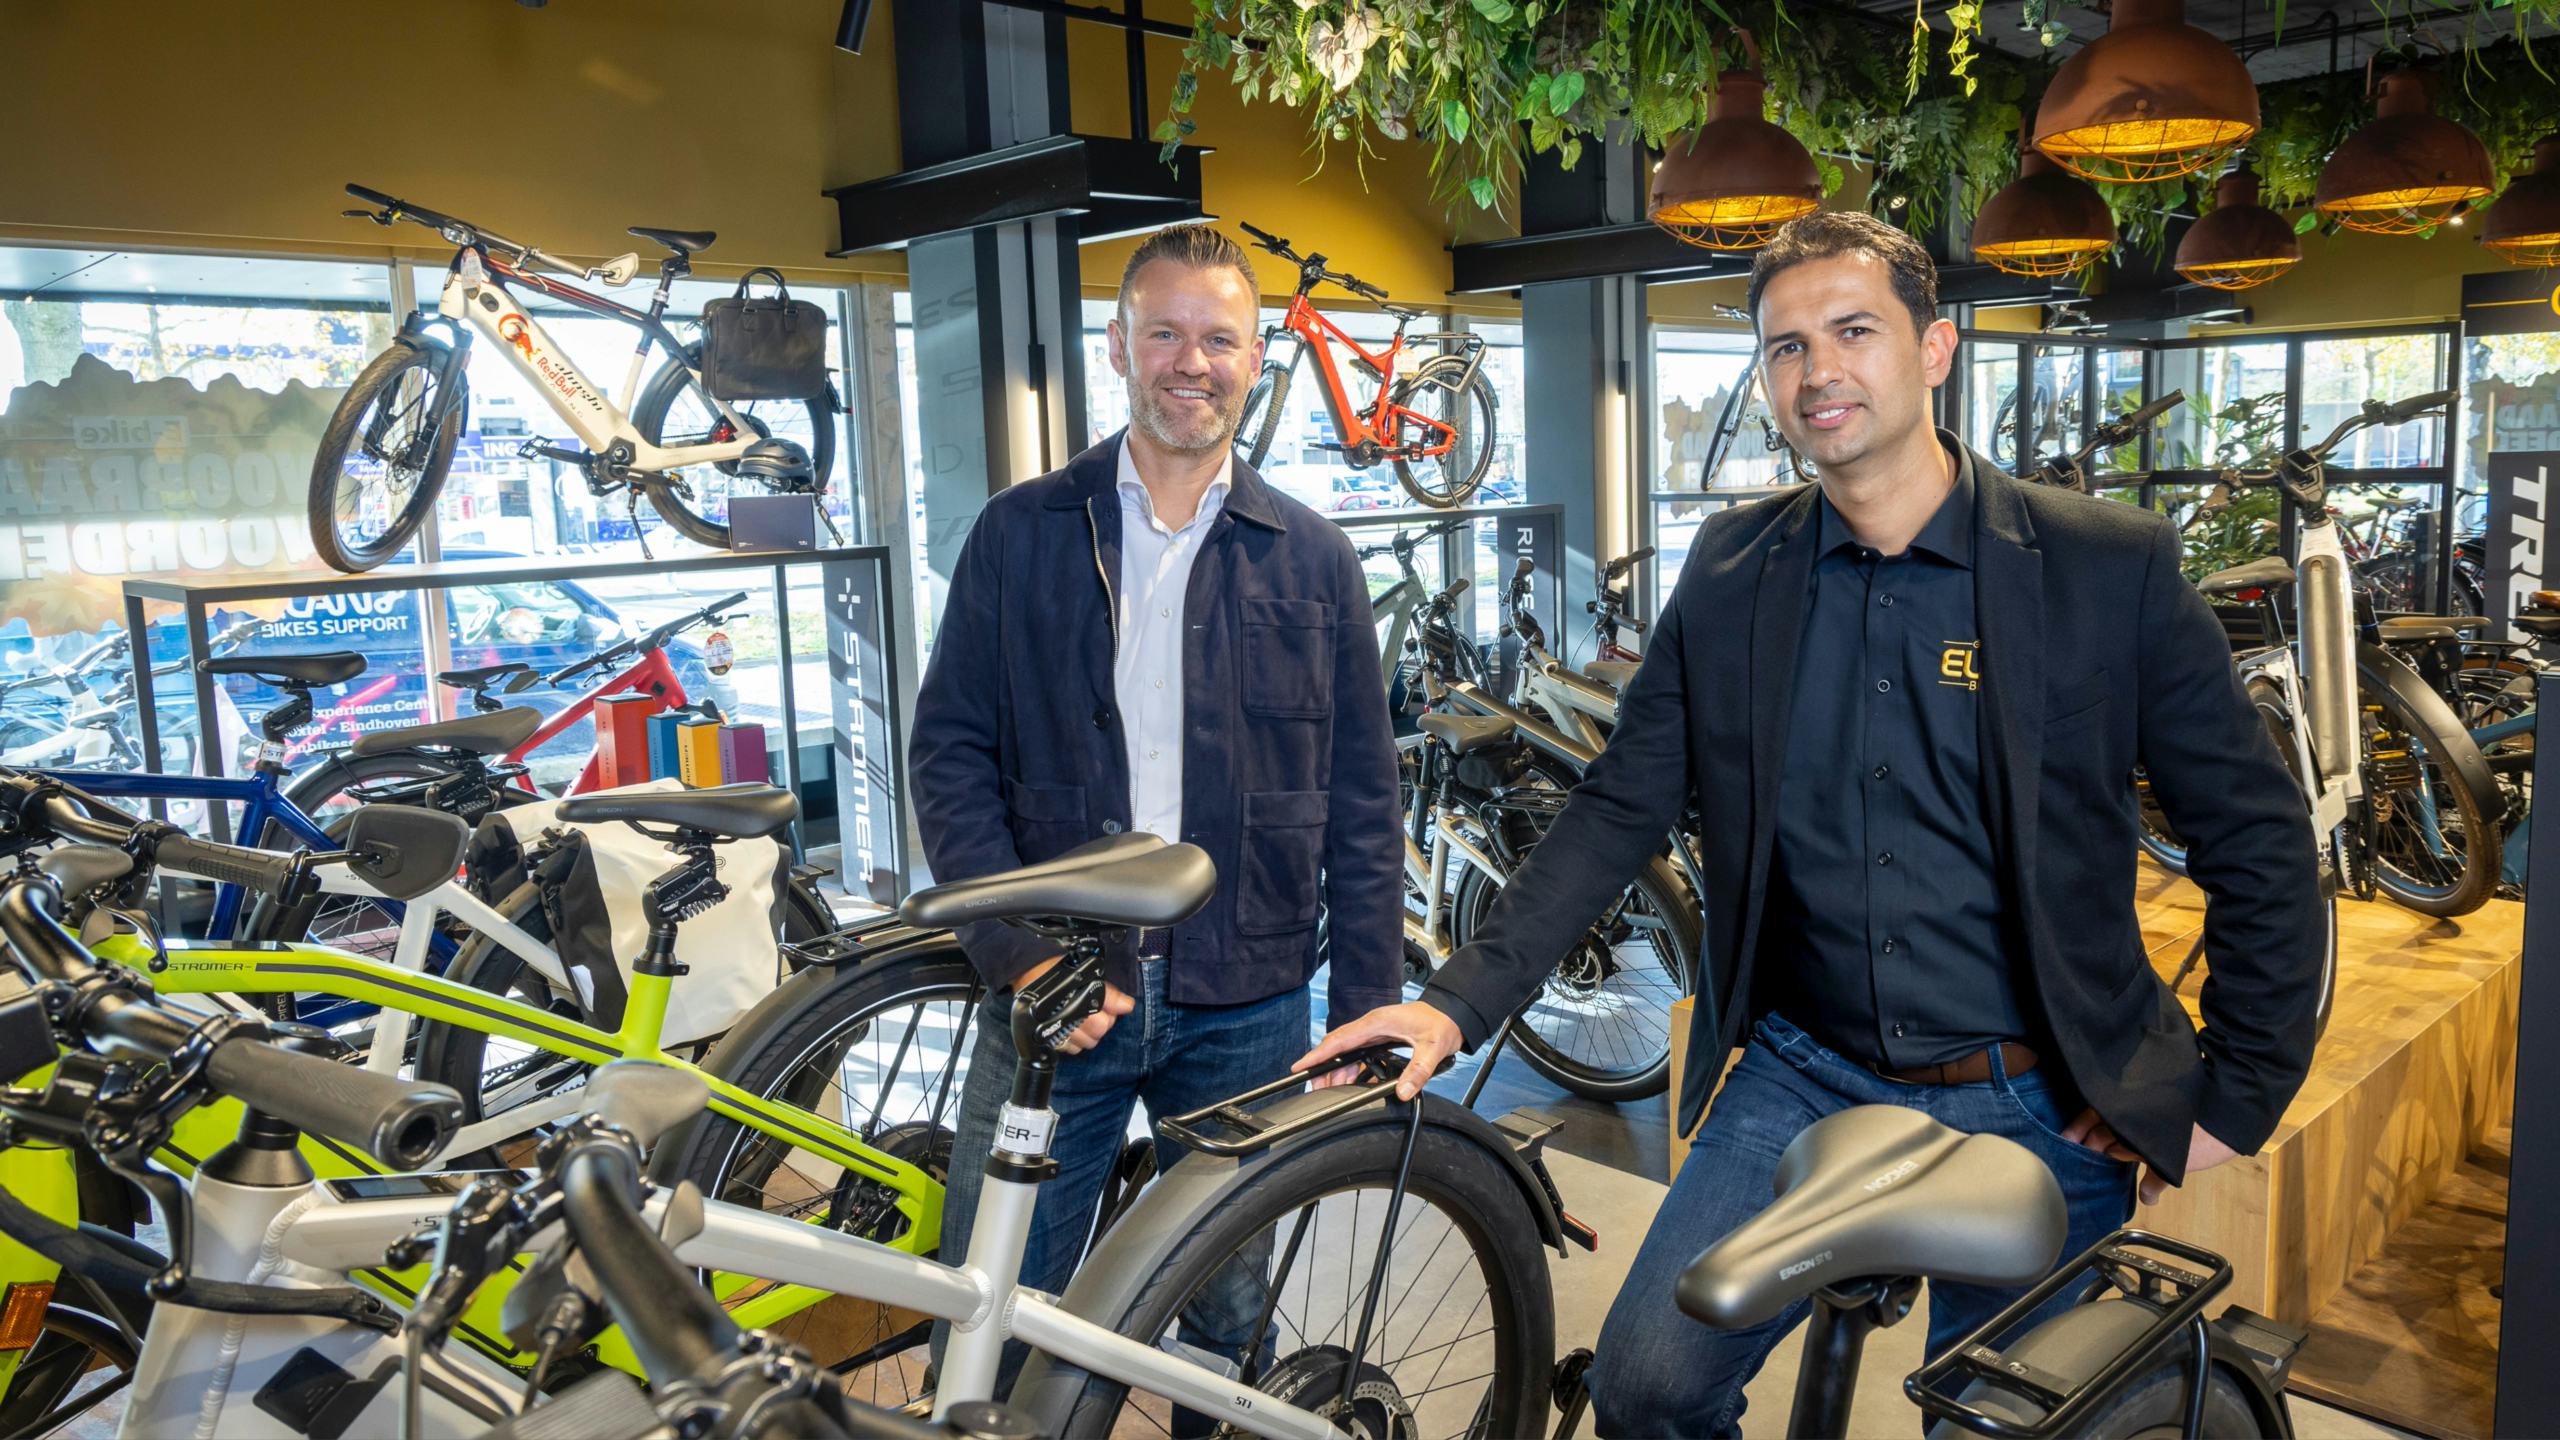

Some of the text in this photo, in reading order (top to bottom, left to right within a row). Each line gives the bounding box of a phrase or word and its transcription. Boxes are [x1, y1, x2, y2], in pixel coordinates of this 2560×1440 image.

[1516, 527, 1535, 610] RIE
[262, 615, 408, 638] BIKES SUPPORT
[394, 697, 431, 714] Cent
[339, 717, 421, 734] Eindhoven
[843, 631, 874, 884] STROMER
[965, 896, 997, 909] ERGON
[1862, 1159, 1920, 1192] ERGON
[1779, 1257, 1816, 1281] ERGON
